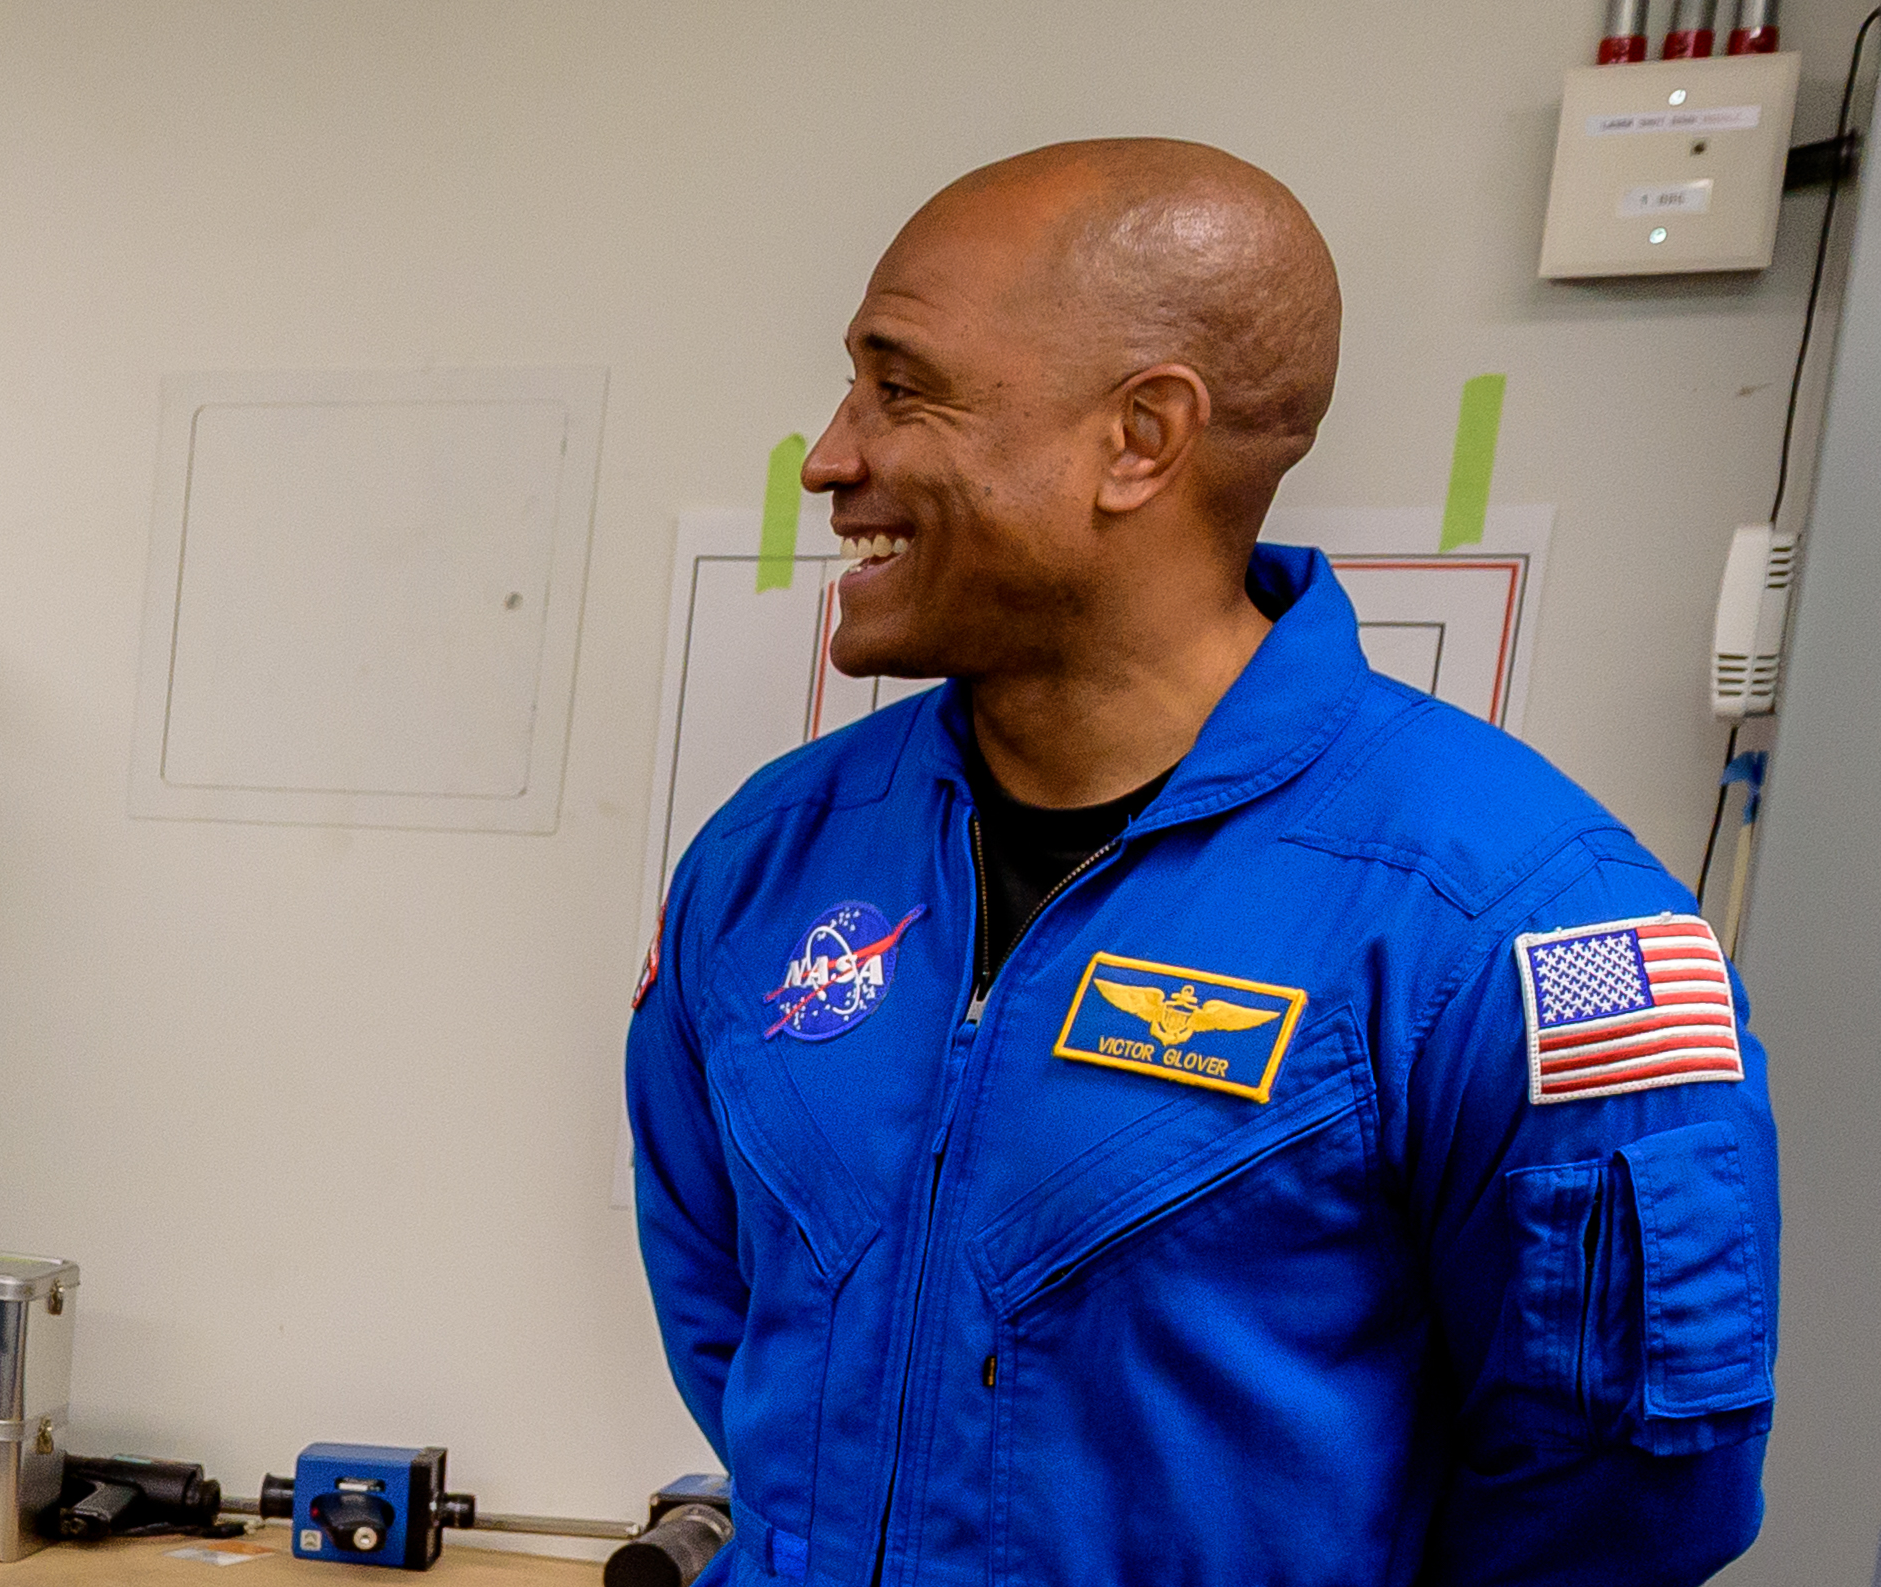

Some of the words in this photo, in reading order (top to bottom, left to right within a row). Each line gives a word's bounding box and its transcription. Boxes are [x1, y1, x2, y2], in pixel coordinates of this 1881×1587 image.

[784, 954, 884, 989] NASA
[1098, 1034, 1155, 1062] VICTOR
[1162, 1048, 1229, 1077] GLOVER
